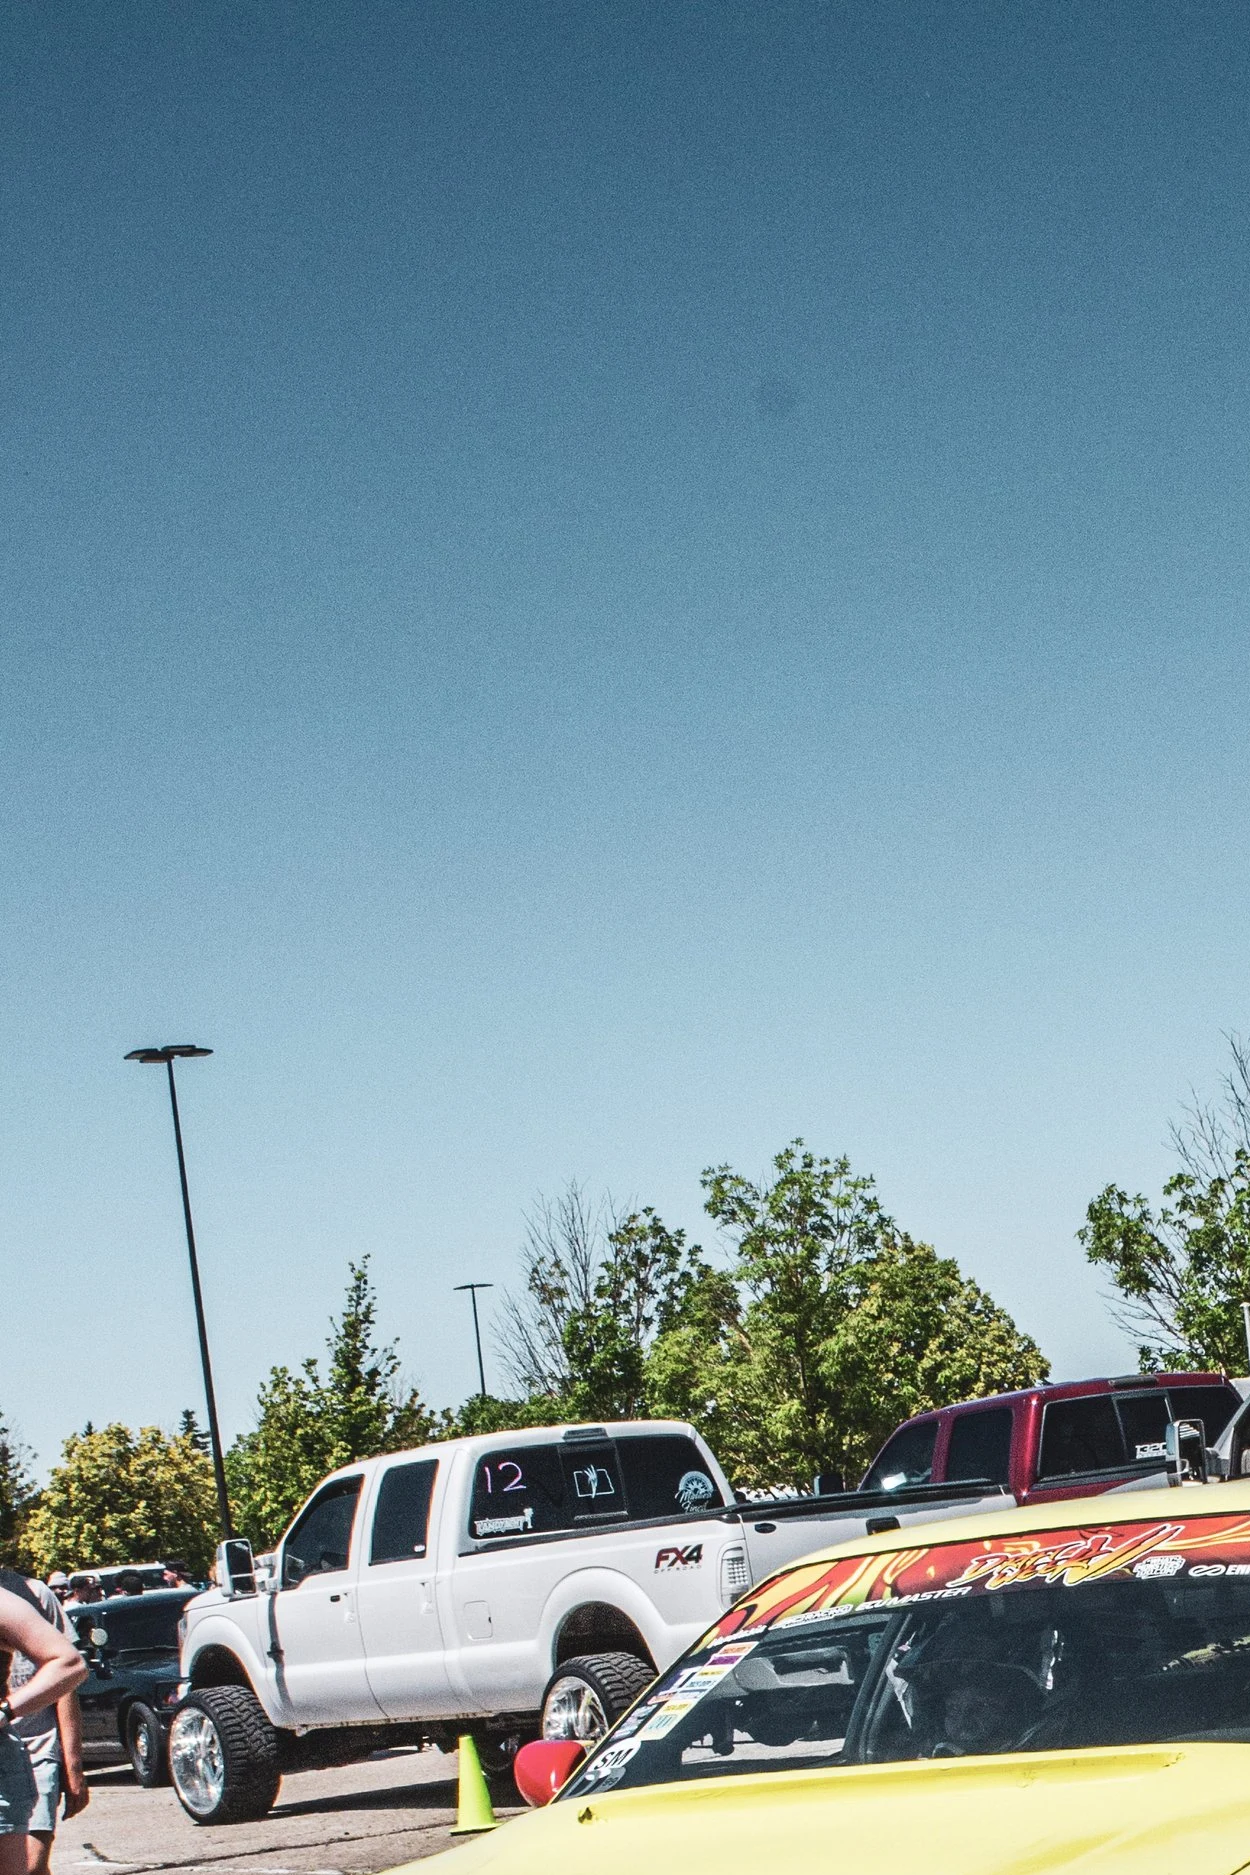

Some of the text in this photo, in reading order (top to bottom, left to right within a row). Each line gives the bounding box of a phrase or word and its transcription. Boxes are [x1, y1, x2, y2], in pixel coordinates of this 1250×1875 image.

[484, 1461, 527, 1494] 12
[654, 1543, 704, 1569] FX4
[594, 1748, 634, 1771] SM
